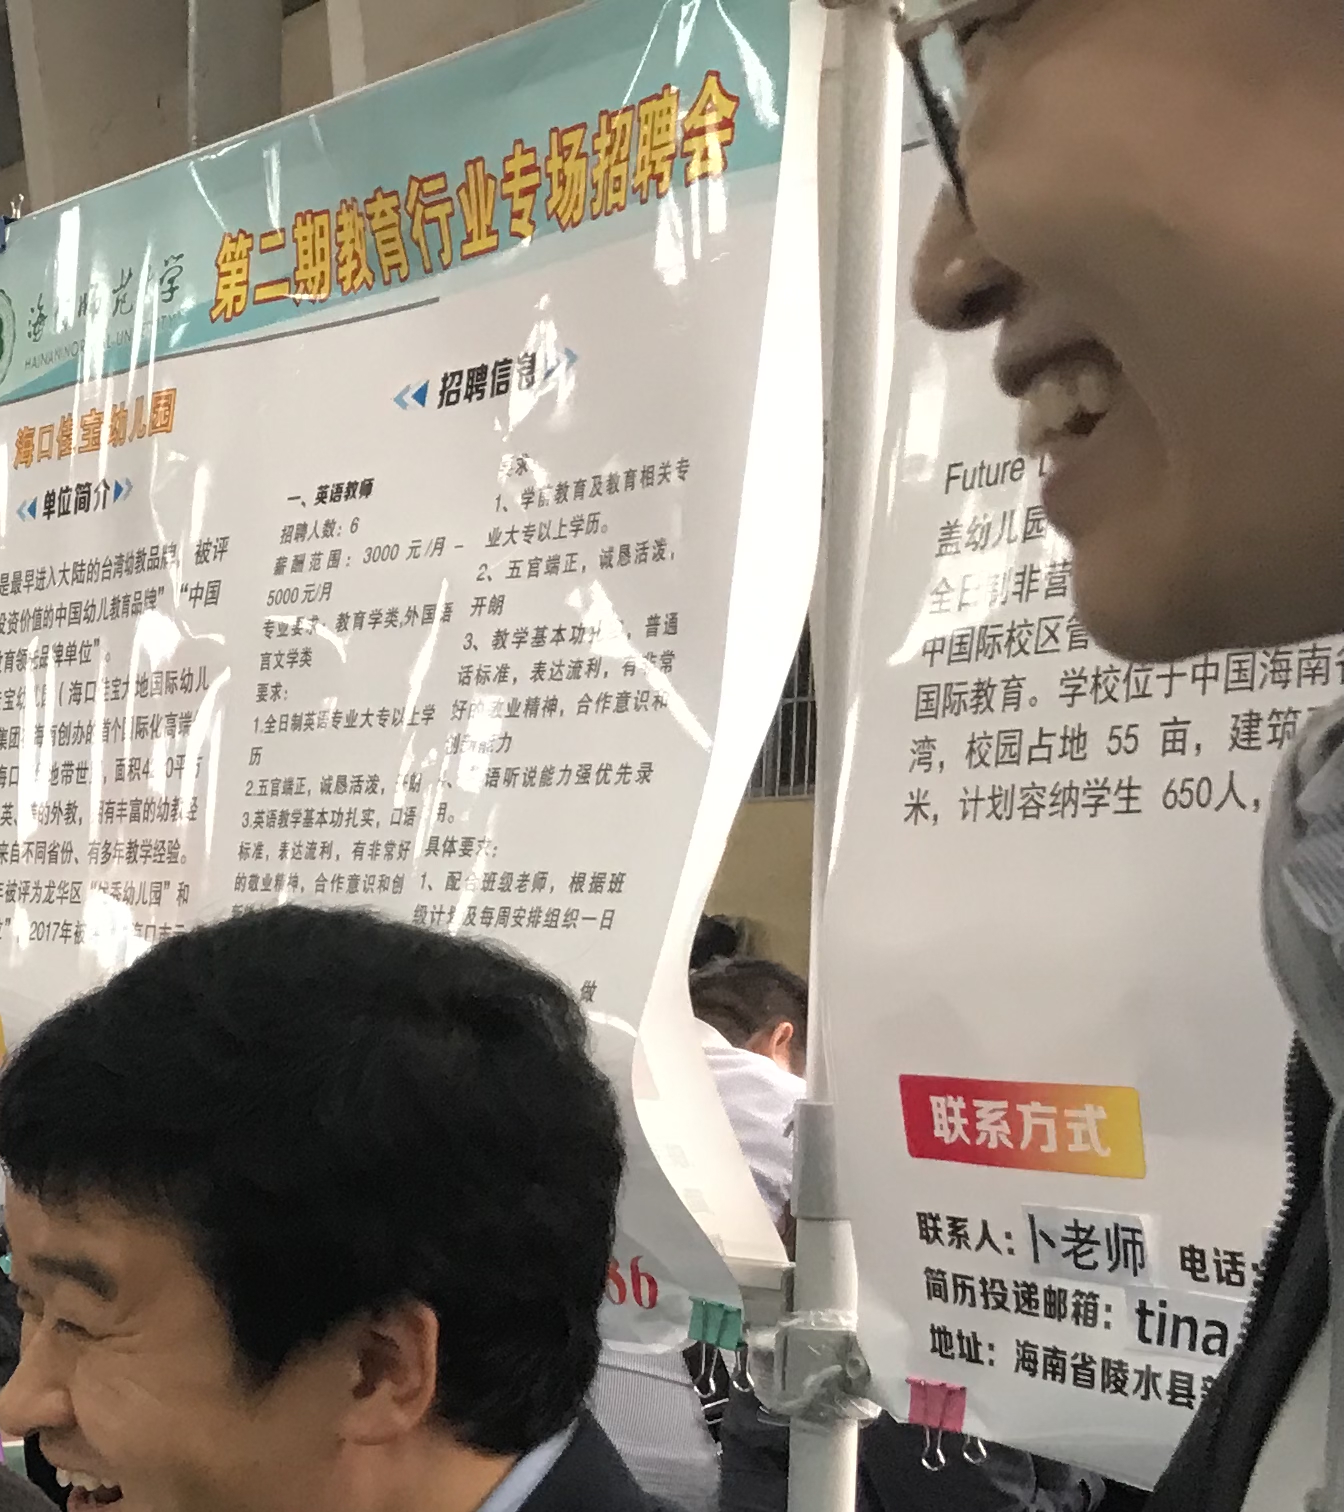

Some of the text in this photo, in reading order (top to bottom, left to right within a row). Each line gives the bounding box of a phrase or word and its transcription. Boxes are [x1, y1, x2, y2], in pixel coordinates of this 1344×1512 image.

[209, 69, 740, 323] 第二期教育行业专场招聘会
[437, 351, 537, 411] 招聘信息
[13, 388, 177, 470] 海口佳宝幼儿园
[287, 478, 375, 508] 一、英语教师
[945, 456, 1026, 495] Future
[42, 478, 110, 520] 单位简介
[485, 511, 609, 548] 业大专以上学历。
[935, 504, 1048, 558] 盖幼儿园
[362, 543, 400, 564] 3000
[470, 593, 506, 617] 开朗
[259, 646, 313, 671] 言文学类
[248, 746, 263, 766] 历
[1107, 723, 1139, 757] 55
[903, 775, 1143, 826] 米，计划容纳学生
[928, 1094, 1112, 1157] 联系方式
[922, 1266, 1113, 1330] 简历投递邮箱：
